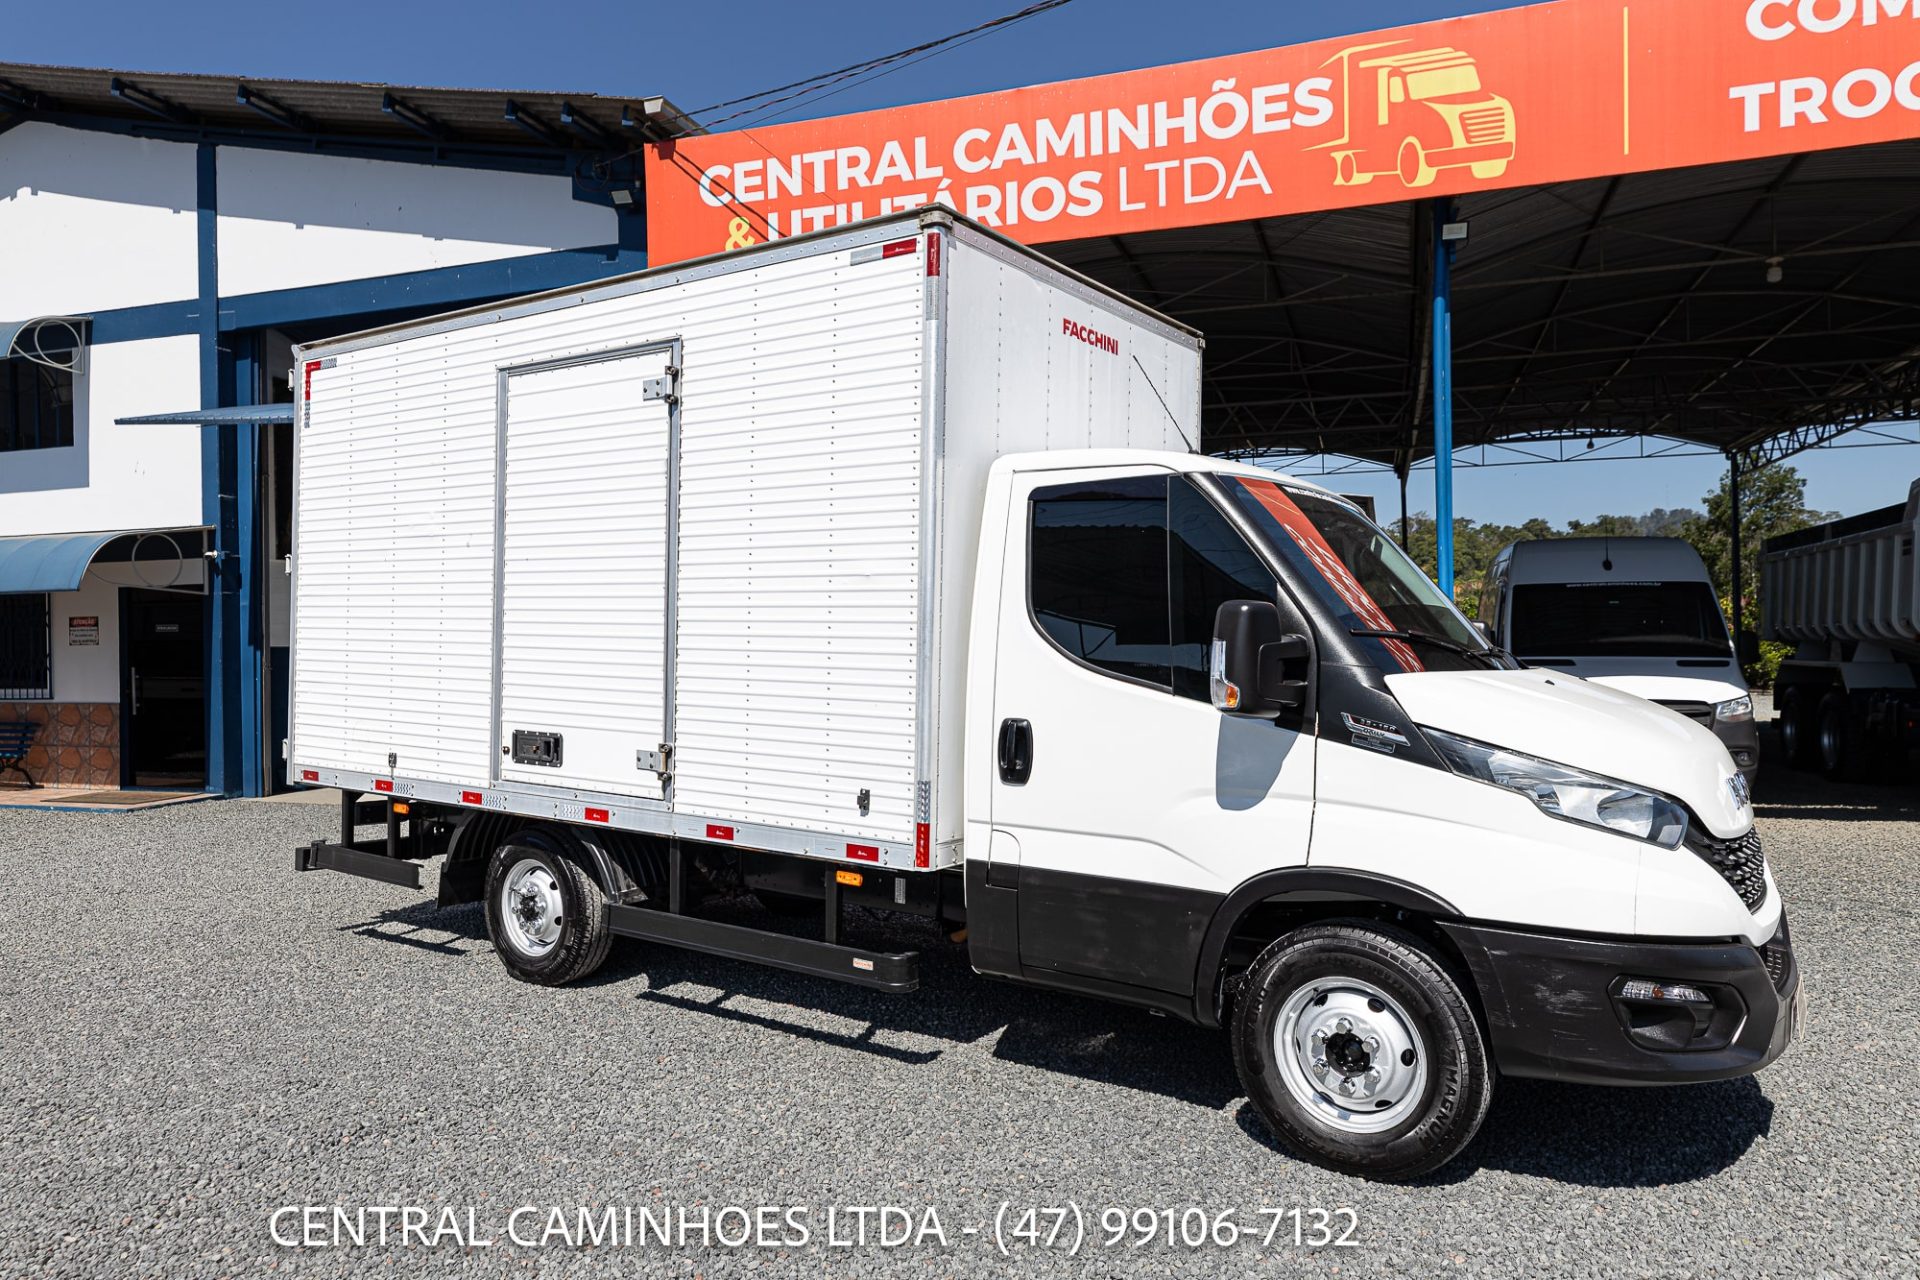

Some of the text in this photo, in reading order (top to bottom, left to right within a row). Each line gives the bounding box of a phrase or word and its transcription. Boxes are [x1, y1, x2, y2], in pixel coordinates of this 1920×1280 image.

[699, 77, 1334, 207] CENTRAL CAMINHÕES
[1119, 150, 1273, 211] LTDA
[1063, 318, 1118, 356] FACCHINI
